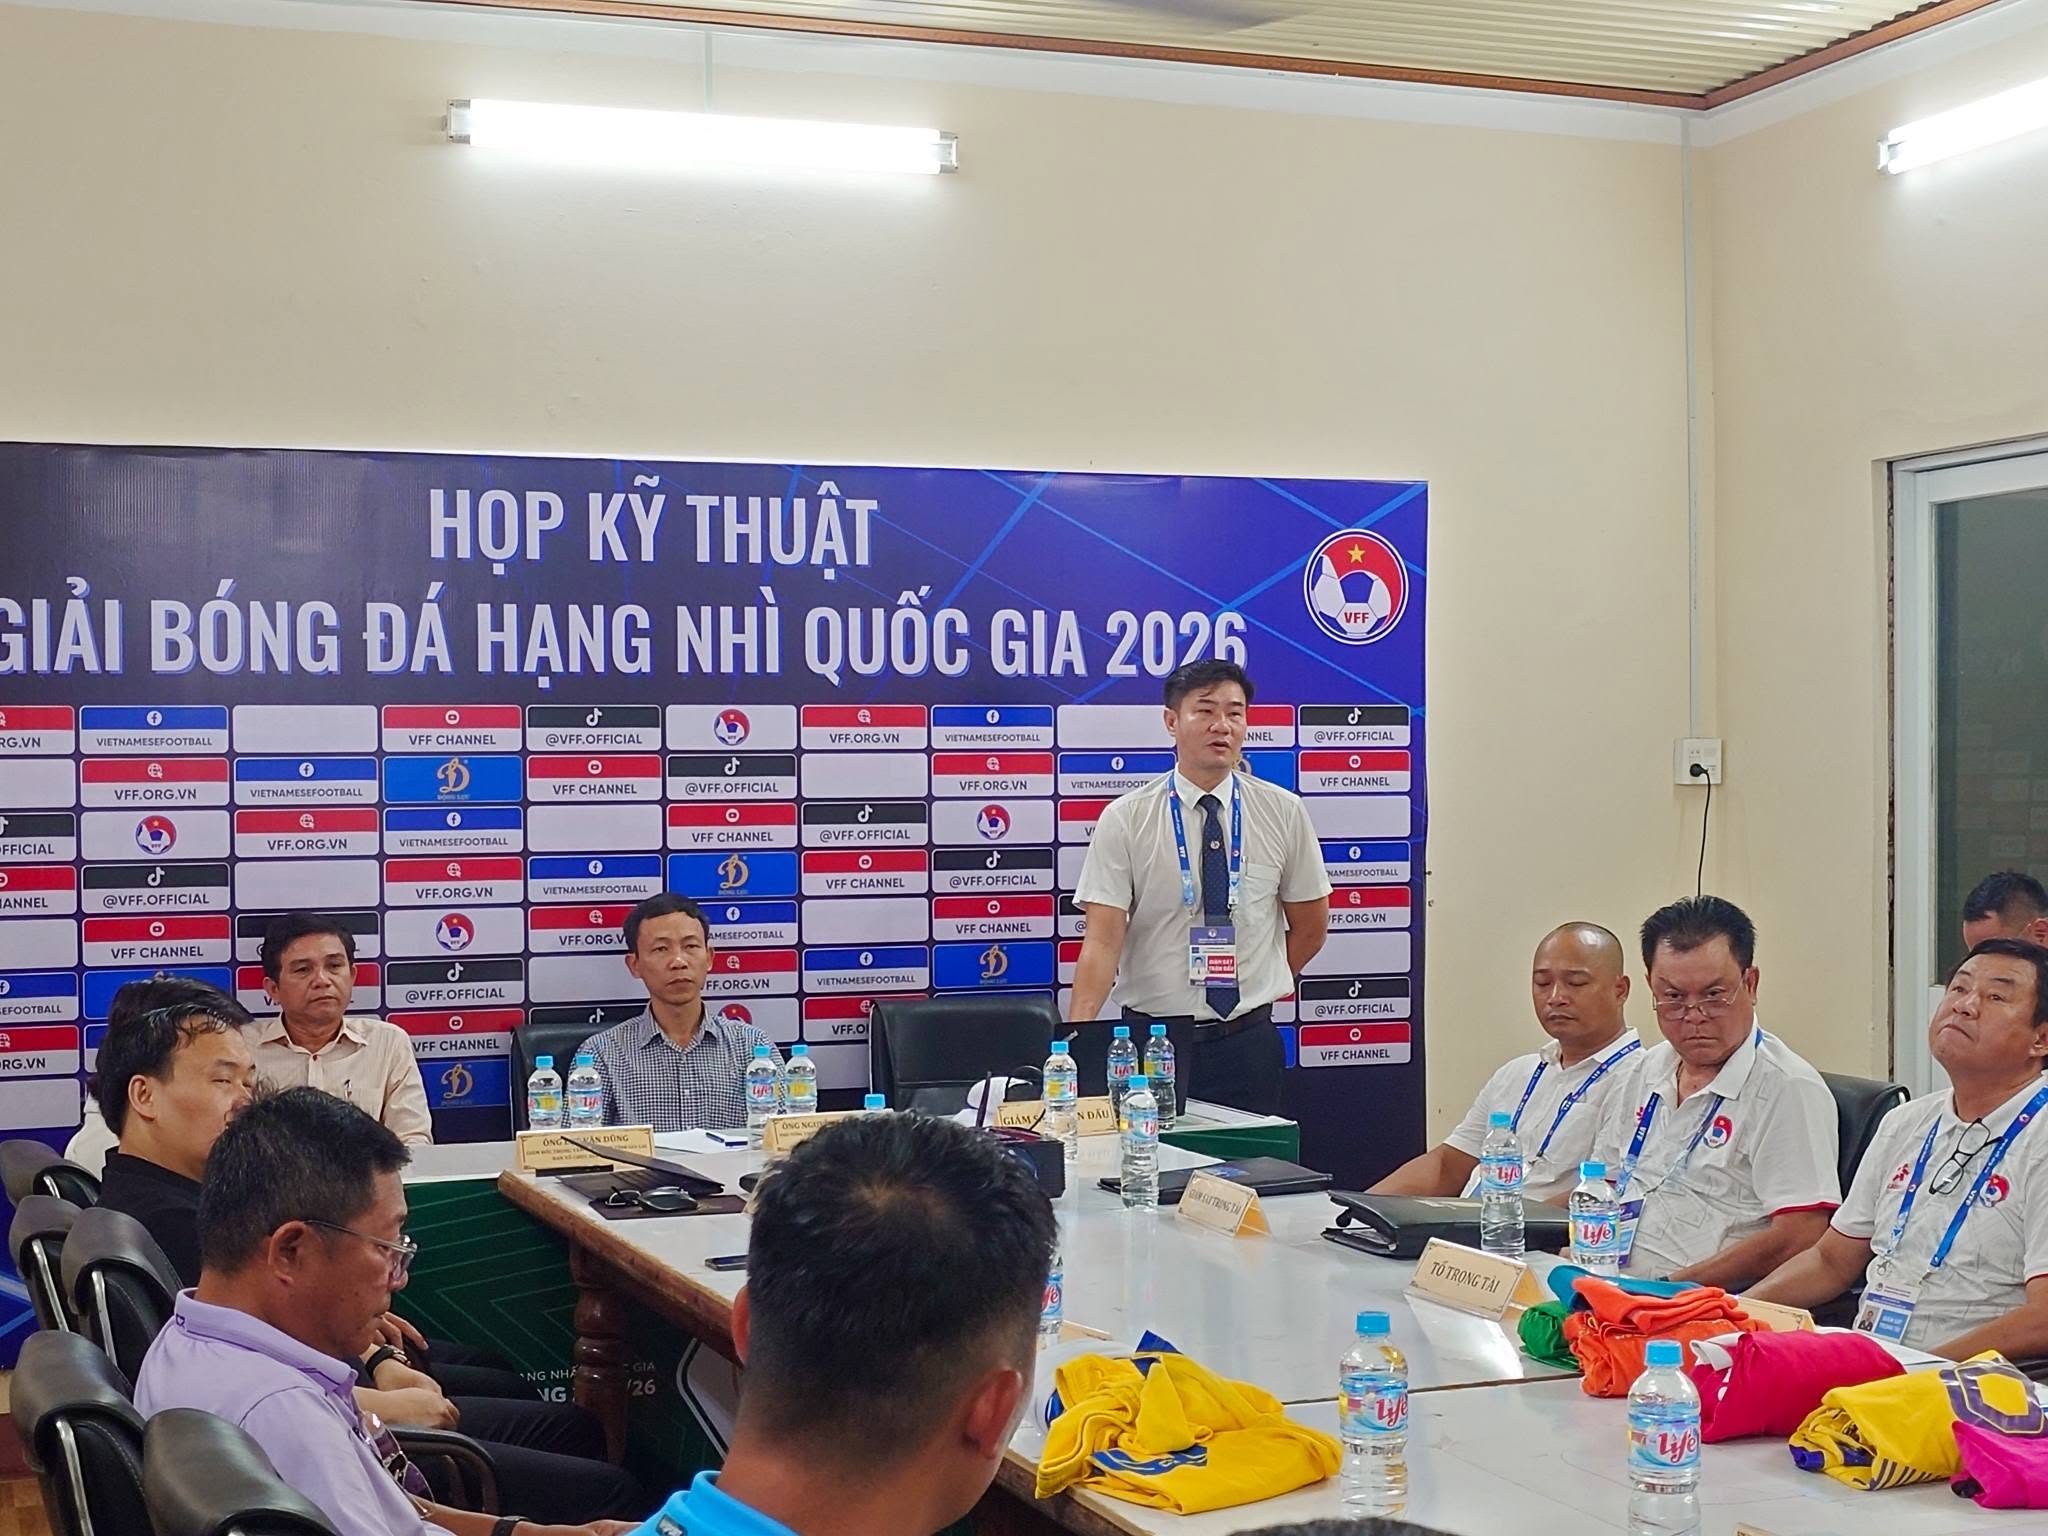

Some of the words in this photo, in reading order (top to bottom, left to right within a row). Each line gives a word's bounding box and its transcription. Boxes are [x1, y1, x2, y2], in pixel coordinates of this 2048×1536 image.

[430, 488, 564, 575] HỌP
[588, 475, 666, 562] KỸ
[686, 480, 878, 580] THUẬT
[1344, 612, 1369, 624] VFF
[150, 578, 338, 674] BÓNG
[363, 582, 452, 673] ĐÁ
[477, 602, 651, 689] HẠNG
[676, 586, 780, 675] NHÌ
[804, 585, 970, 687] QUỐC
[991, 609, 1086, 676] GIA
[1106, 610, 1248, 676] 2026
[96, 737, 212, 747] VIETNAMESEFOOTBALL
[408, 734, 432, 746] VFF
[435, 734, 496, 746] CHANNEL
[545, 733, 642, 747] @VFF.OFFICIAL
[829, 733, 900, 744] VFF.ORG.VN
[944, 733, 1040, 742] VIETNAMESEFOOTBALL
[1314, 730, 1394, 744] @VFF.OFFICIAL
[959, 780, 1027, 791] VFF.ORG.VN
[1319, 777, 1339, 787] VFF
[1341, 776, 1389, 787] CHANNEL
[114, 788, 197, 801] VFF.ORG.VN
[250, 788, 363, 798] VIETNAMESEFOOTBALL
[552, 784, 575, 795] VFF
[578, 783, 635, 795] CHANNEL
[684, 782, 779, 796] @VFF.OFFICIAL
[399, 837, 508, 847] VIETNAMESEFOOTBALL
[691, 832, 714, 843] VFF
[716, 831, 773, 843] CHANNEL
[819, 829, 911, 843] @VFF.OFFICIAL
[267, 838, 347, 851] VFF.ORG.VN
[825, 878, 847, 889] VFF
[850, 877, 905, 889] CHANNEL
[949, 875, 1037, 889] @VFF.OFFICIAL
[415, 887, 493, 899] VFF.ORG.VN
[543, 884, 647, 895] VIETNAMESEFOOTBALL
[102, 893, 210, 910] @VFF.OFFICIAL
[955, 923, 976, 934] VFF
[979, 922, 1031, 934] CHANNEL
[111, 947, 136, 959] VFF
[139, 945, 204, 959] CHANNEL
[816, 975, 915, 986] VIETNAMESEFOOTBALL
[405, 987, 506, 1005] @VFF.OFFICIAL
[1314, 1003, 1397, 1020] @VFF.OFFICIAL
[412, 1041, 436, 1053] VFF
[439, 1038, 500, 1052] CHANNEL
[1320, 1050, 1344, 1061] VFF
[1341, 1048, 1389, 1060] CHANNEL
[1003, 1113, 1032, 1126] GIÁM
[543, 1136, 562, 1147] ÔNG
[603, 1133, 629, 1143] DŨNG
[1583, 1222, 1612, 1246] Life
[1445, 1265, 1482, 1287] TRỌNG
[1376, 1394, 1407, 1427] Life
[1658, 1429, 1697, 1464] Life
